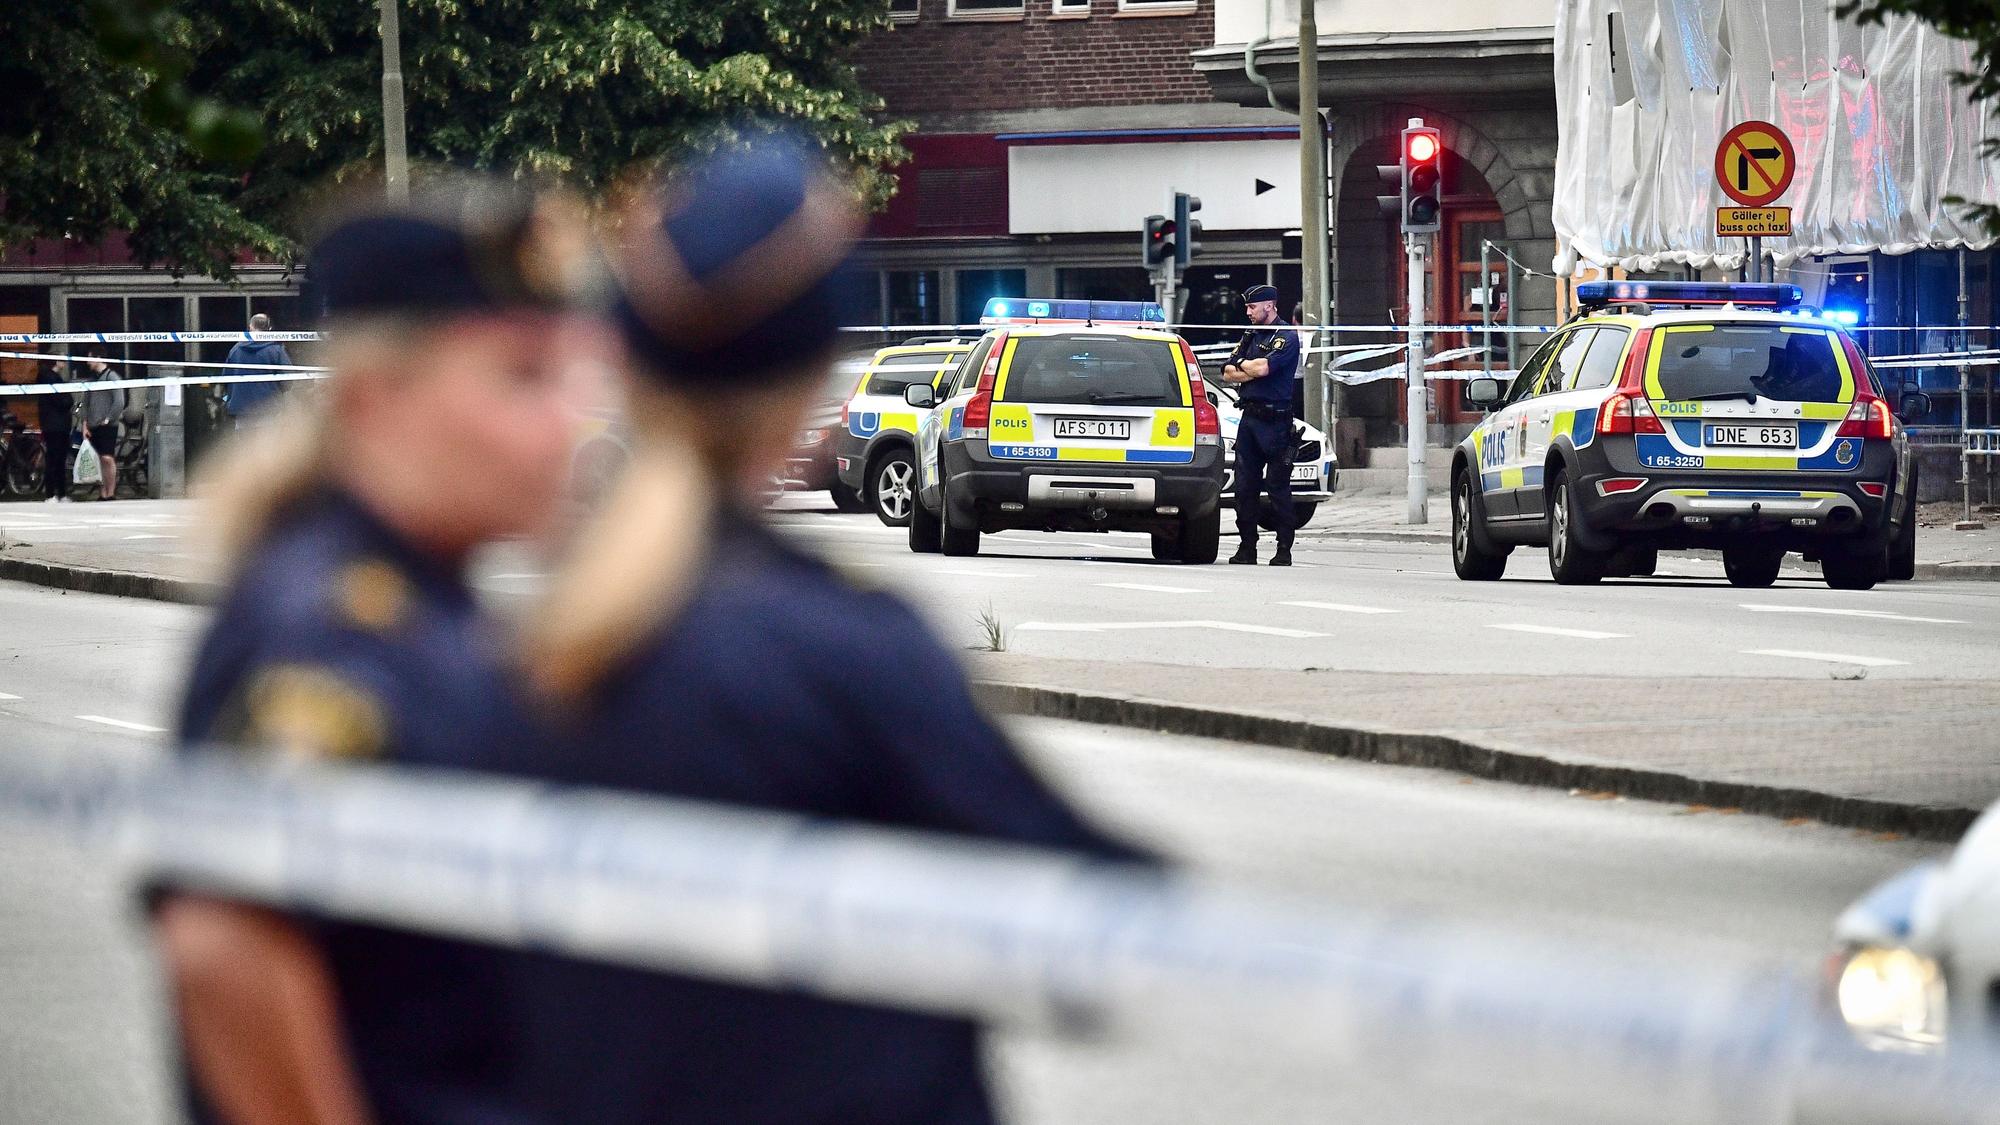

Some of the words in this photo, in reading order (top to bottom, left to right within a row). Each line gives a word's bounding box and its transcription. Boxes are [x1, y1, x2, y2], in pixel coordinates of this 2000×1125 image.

[1732, 211, 1762, 220] Gäller
[1766, 211, 1776, 221] ej
[1720, 223, 1743, 231] buss
[1747, 223, 1764, 231] och
[1768, 223, 1787, 231] taxi
[1660, 403, 1697, 413] POLIS
[995, 419, 1027, 428] POLIS
[1058, 420, 1086, 434] AFS
[1098, 422, 1125, 436] 011
[1715, 428, 1747, 443] DNE
[1760, 429, 1792, 444] 653
[1003, 447, 1008, 456] 1
[1012, 447, 1051, 457] 65-8130
[1482, 430, 1506, 469] POLIS
[1647, 456, 1652, 466] 1
[1656, 456, 1703, 467] 65-3250
[1299, 467, 1314, 478] 107
